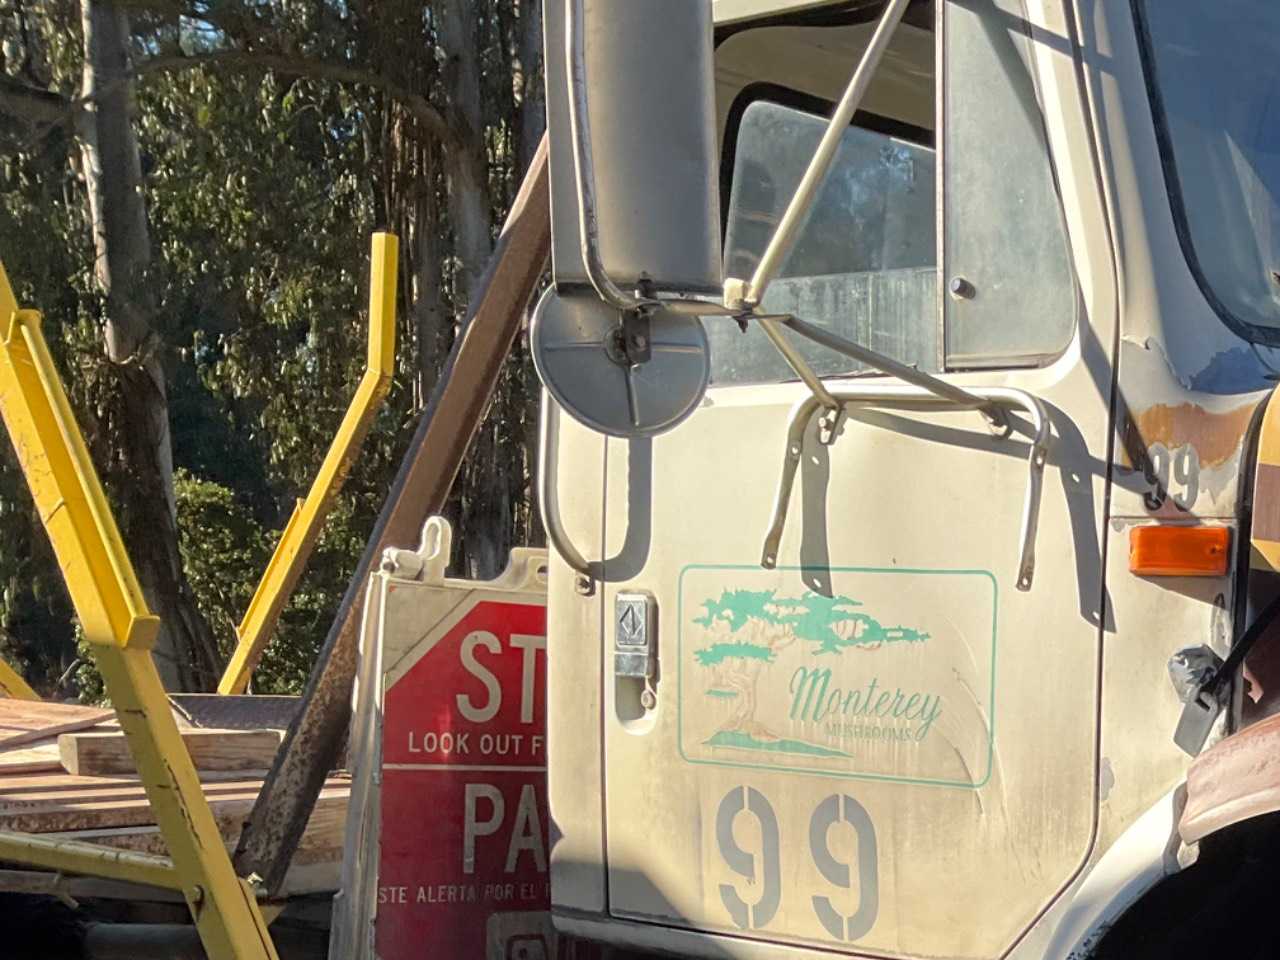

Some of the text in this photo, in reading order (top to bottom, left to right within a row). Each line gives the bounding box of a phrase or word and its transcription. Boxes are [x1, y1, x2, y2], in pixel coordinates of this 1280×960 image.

[789, 666, 942, 742] Monterey
[408, 731, 469, 754] LOOK
[480, 734, 523, 755] OUT
[463, 783, 547, 874] PA
[715, 785, 880, 942] 99
[416, 884, 477, 904] ALERTA
[484, 883, 515, 901] POR
[520, 881, 537, 900] EL
